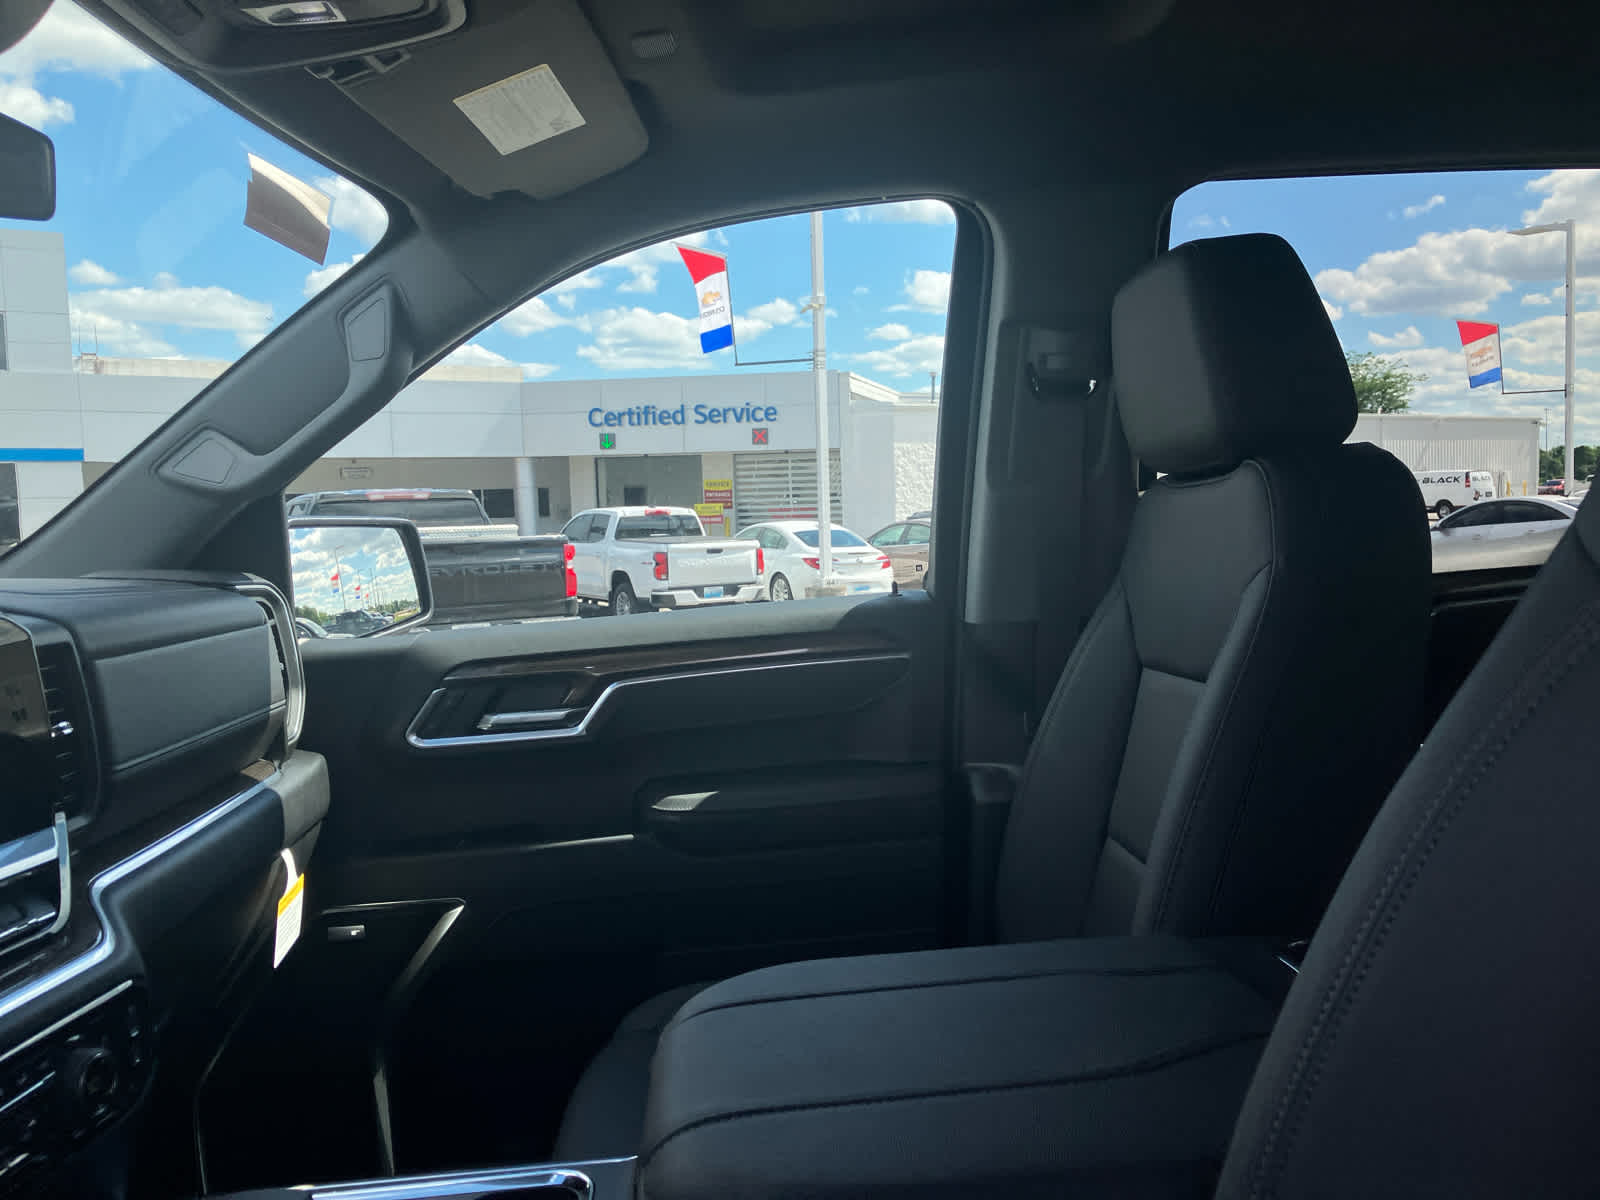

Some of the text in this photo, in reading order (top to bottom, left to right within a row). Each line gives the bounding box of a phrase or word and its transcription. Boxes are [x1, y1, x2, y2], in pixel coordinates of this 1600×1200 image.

[588, 402, 777, 427] Certified Service
[1422, 476, 1461, 484] BLACK
